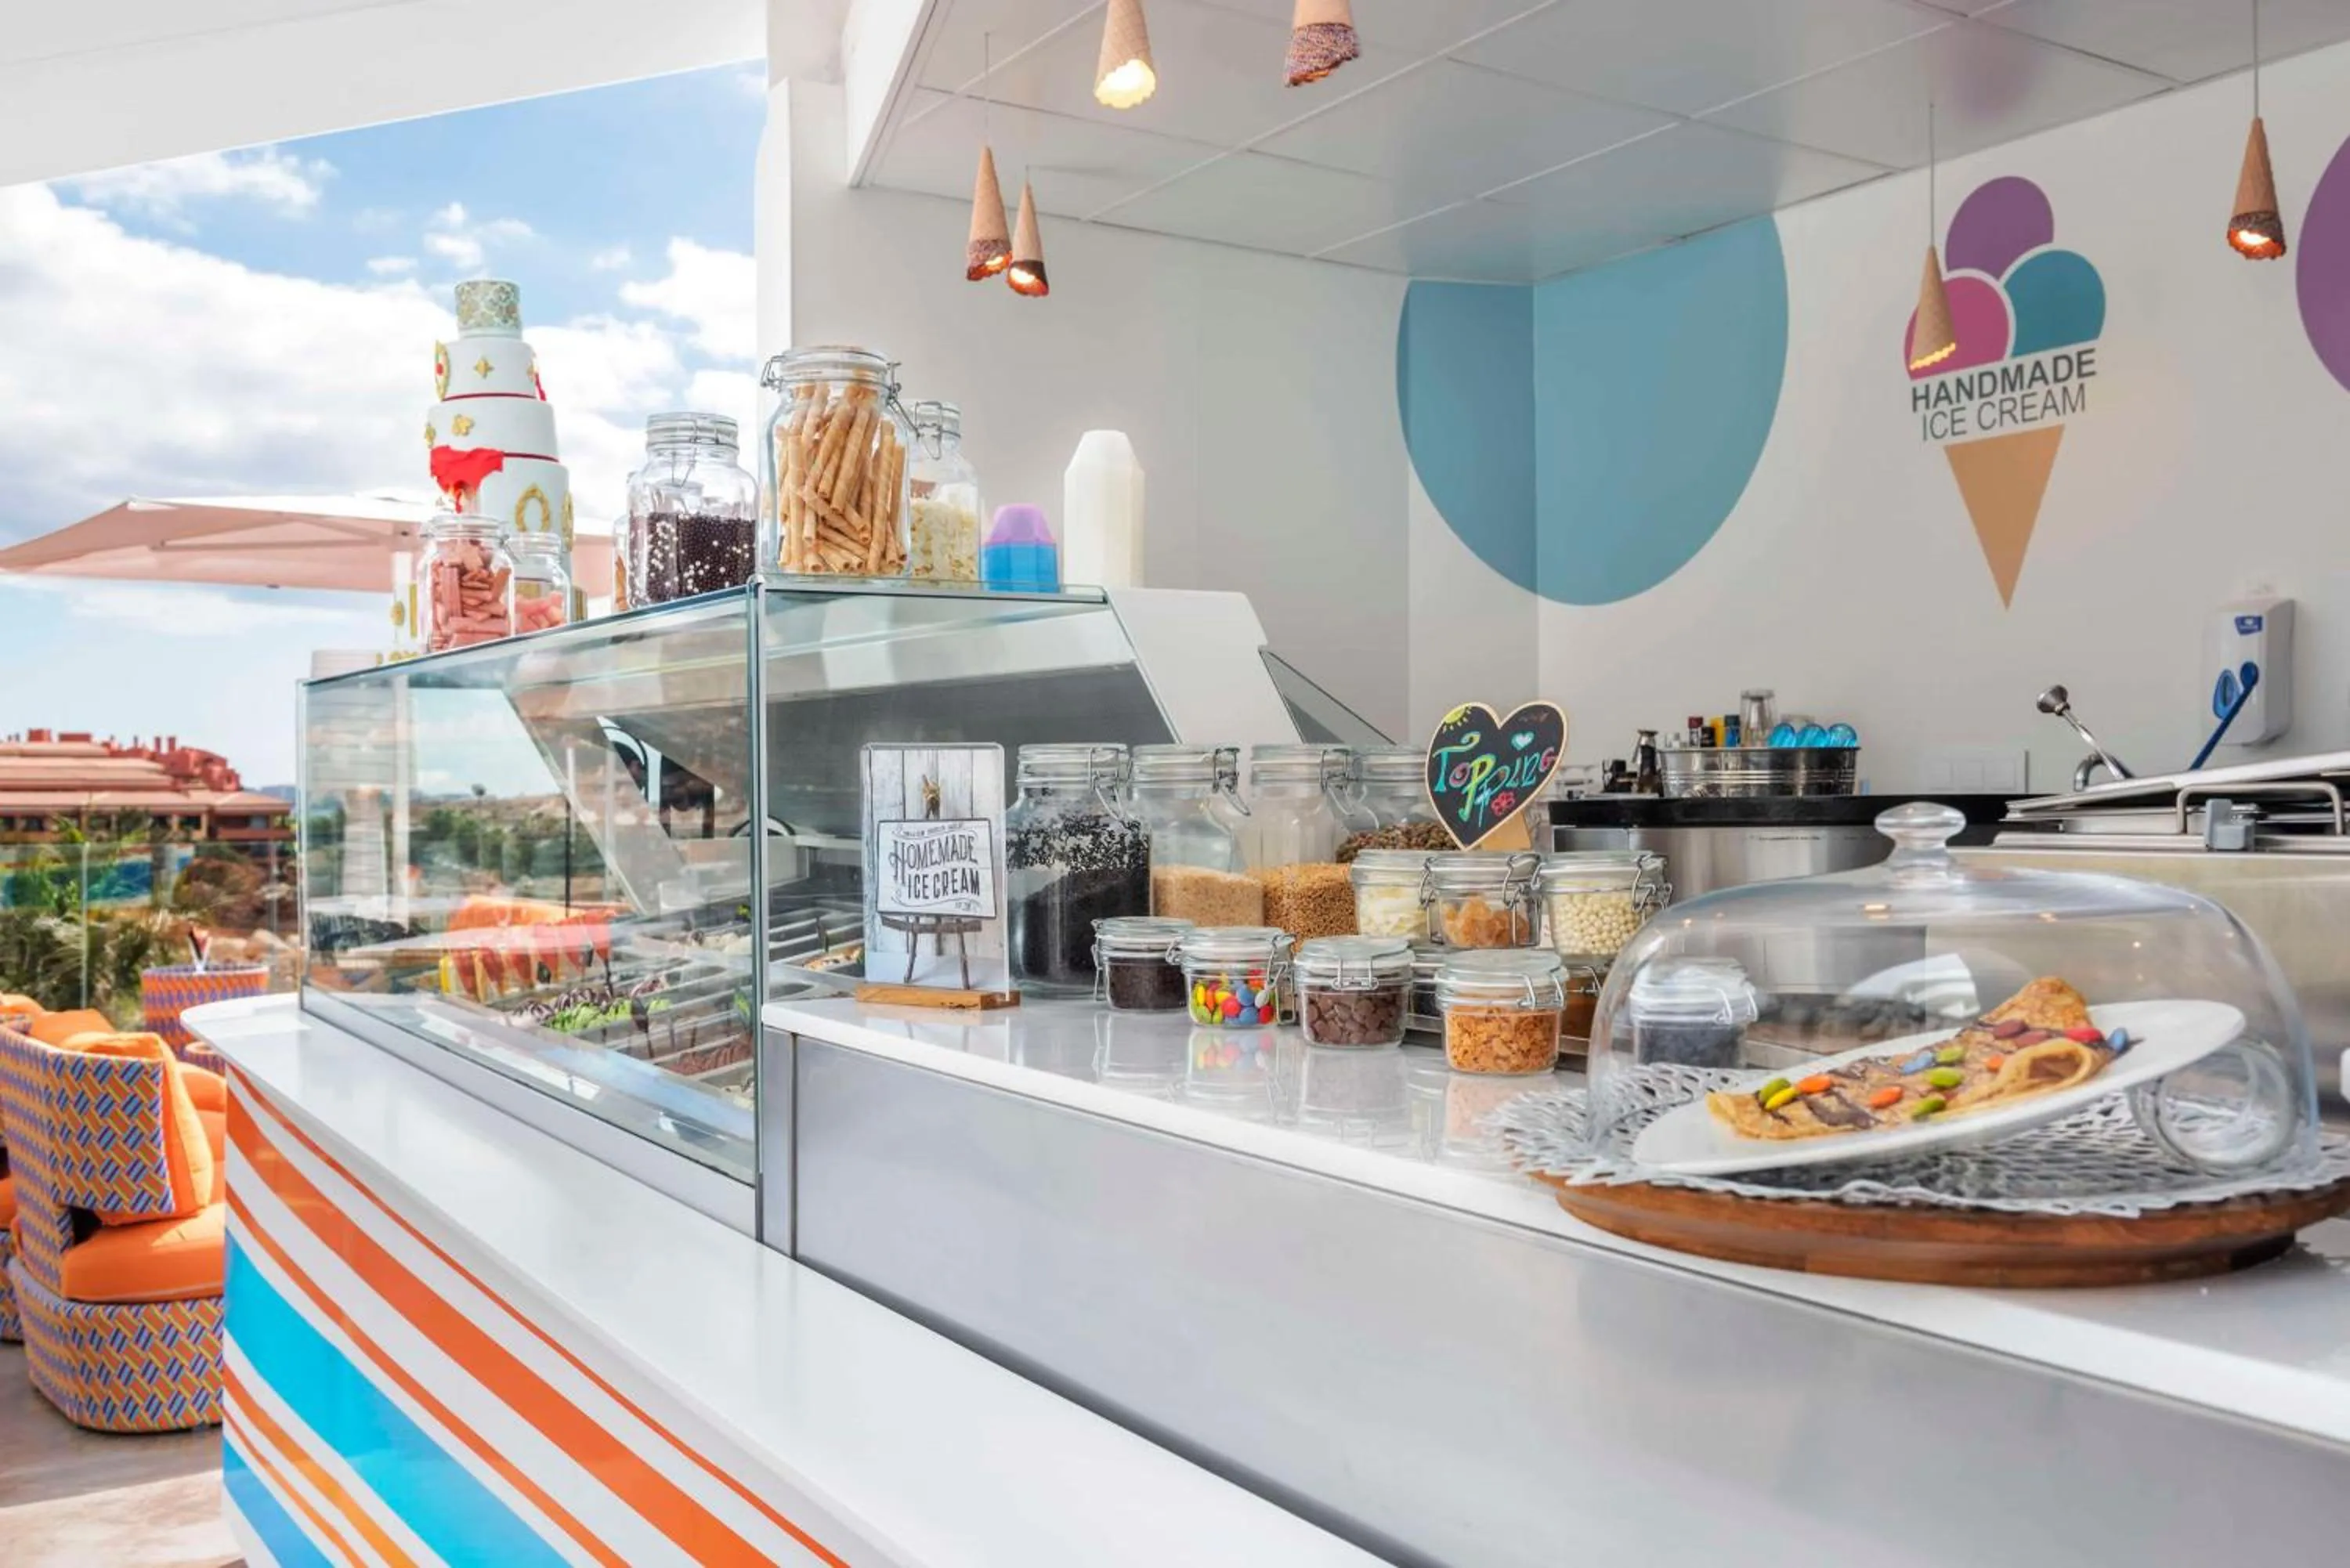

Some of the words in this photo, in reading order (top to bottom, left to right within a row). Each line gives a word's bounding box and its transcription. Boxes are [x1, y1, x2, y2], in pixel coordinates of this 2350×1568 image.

[1911, 348, 2097, 413] HANDMADE
[1922, 406, 1967, 442] ICE
[1976, 383, 2086, 432] CREAM
[888, 834, 978, 887] HOMEMADE
[907, 873, 930, 900] ICE
[933, 866, 981, 900] CREAM
